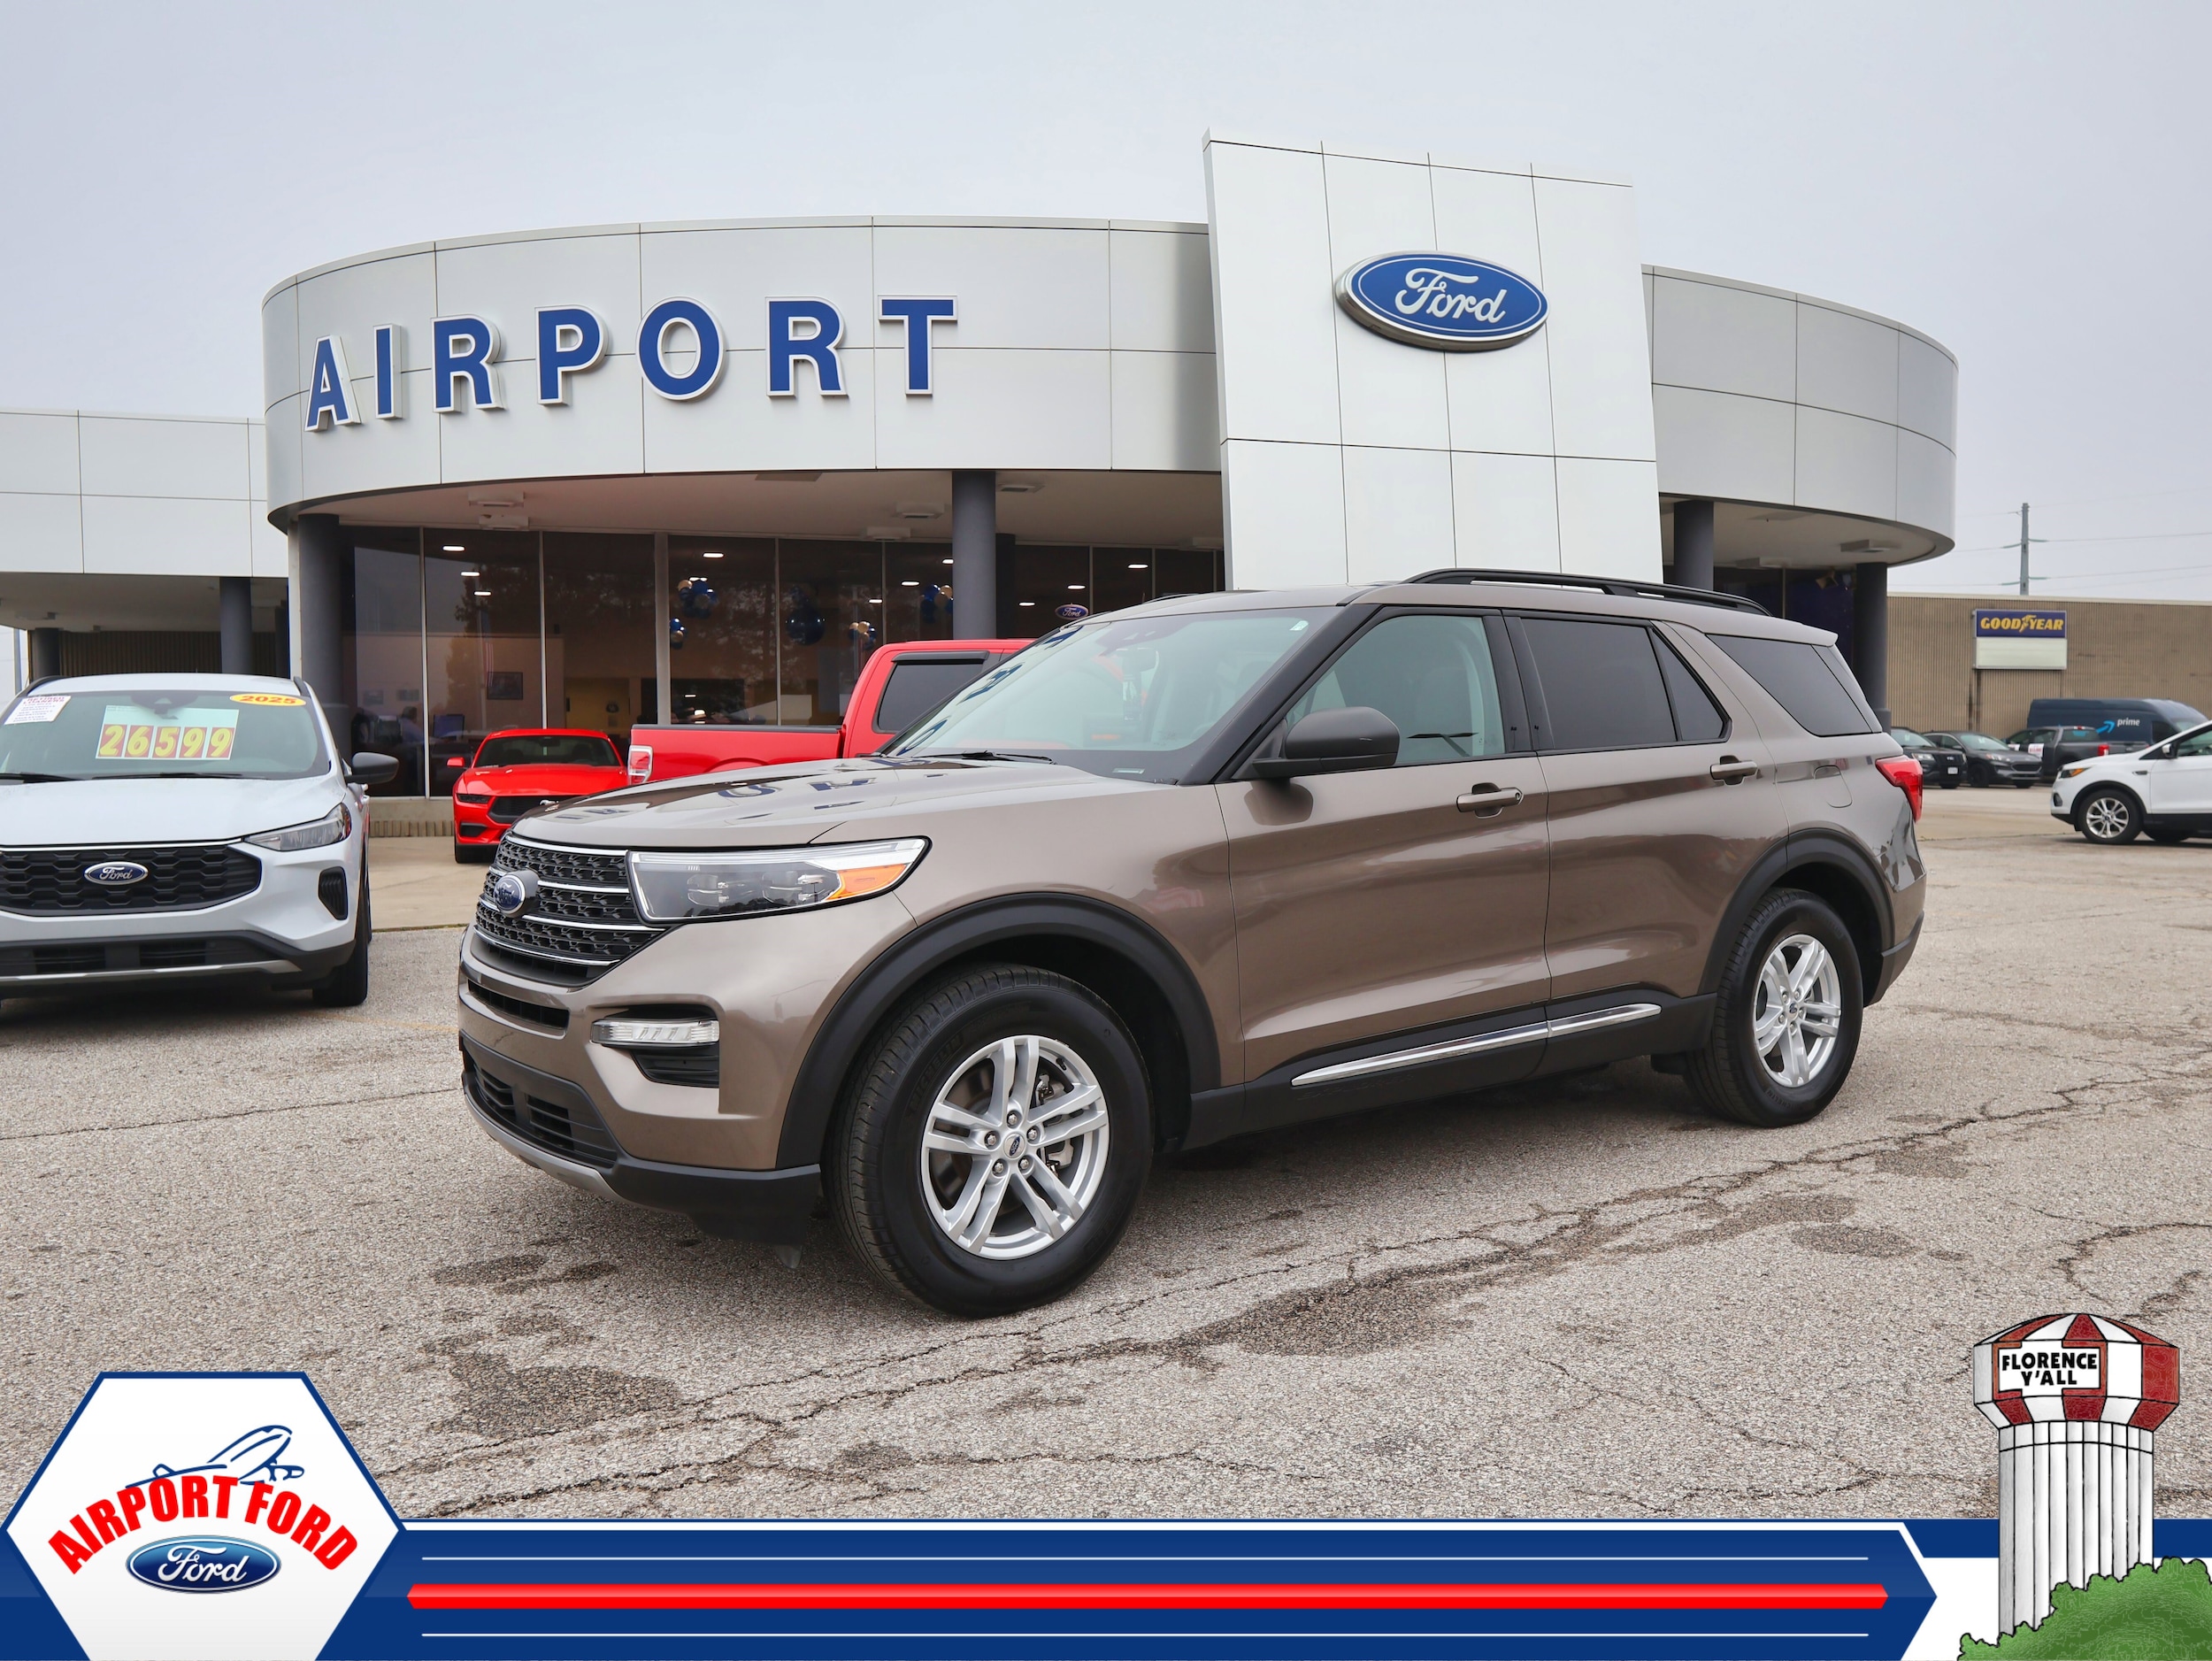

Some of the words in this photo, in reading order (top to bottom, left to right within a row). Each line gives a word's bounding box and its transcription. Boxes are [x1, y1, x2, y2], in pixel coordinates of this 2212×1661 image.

[1394, 267, 1508, 324] Ford
[304, 295, 958, 433] AIRPORT
[1062, 607, 1082, 617] Ford
[1980, 616, 2064, 631] GOODYEAR
[241, 696, 296, 705] 2025
[2116, 717, 2141, 727] prime
[99, 724, 234, 757] 26599
[99, 866, 134, 880] Ford
